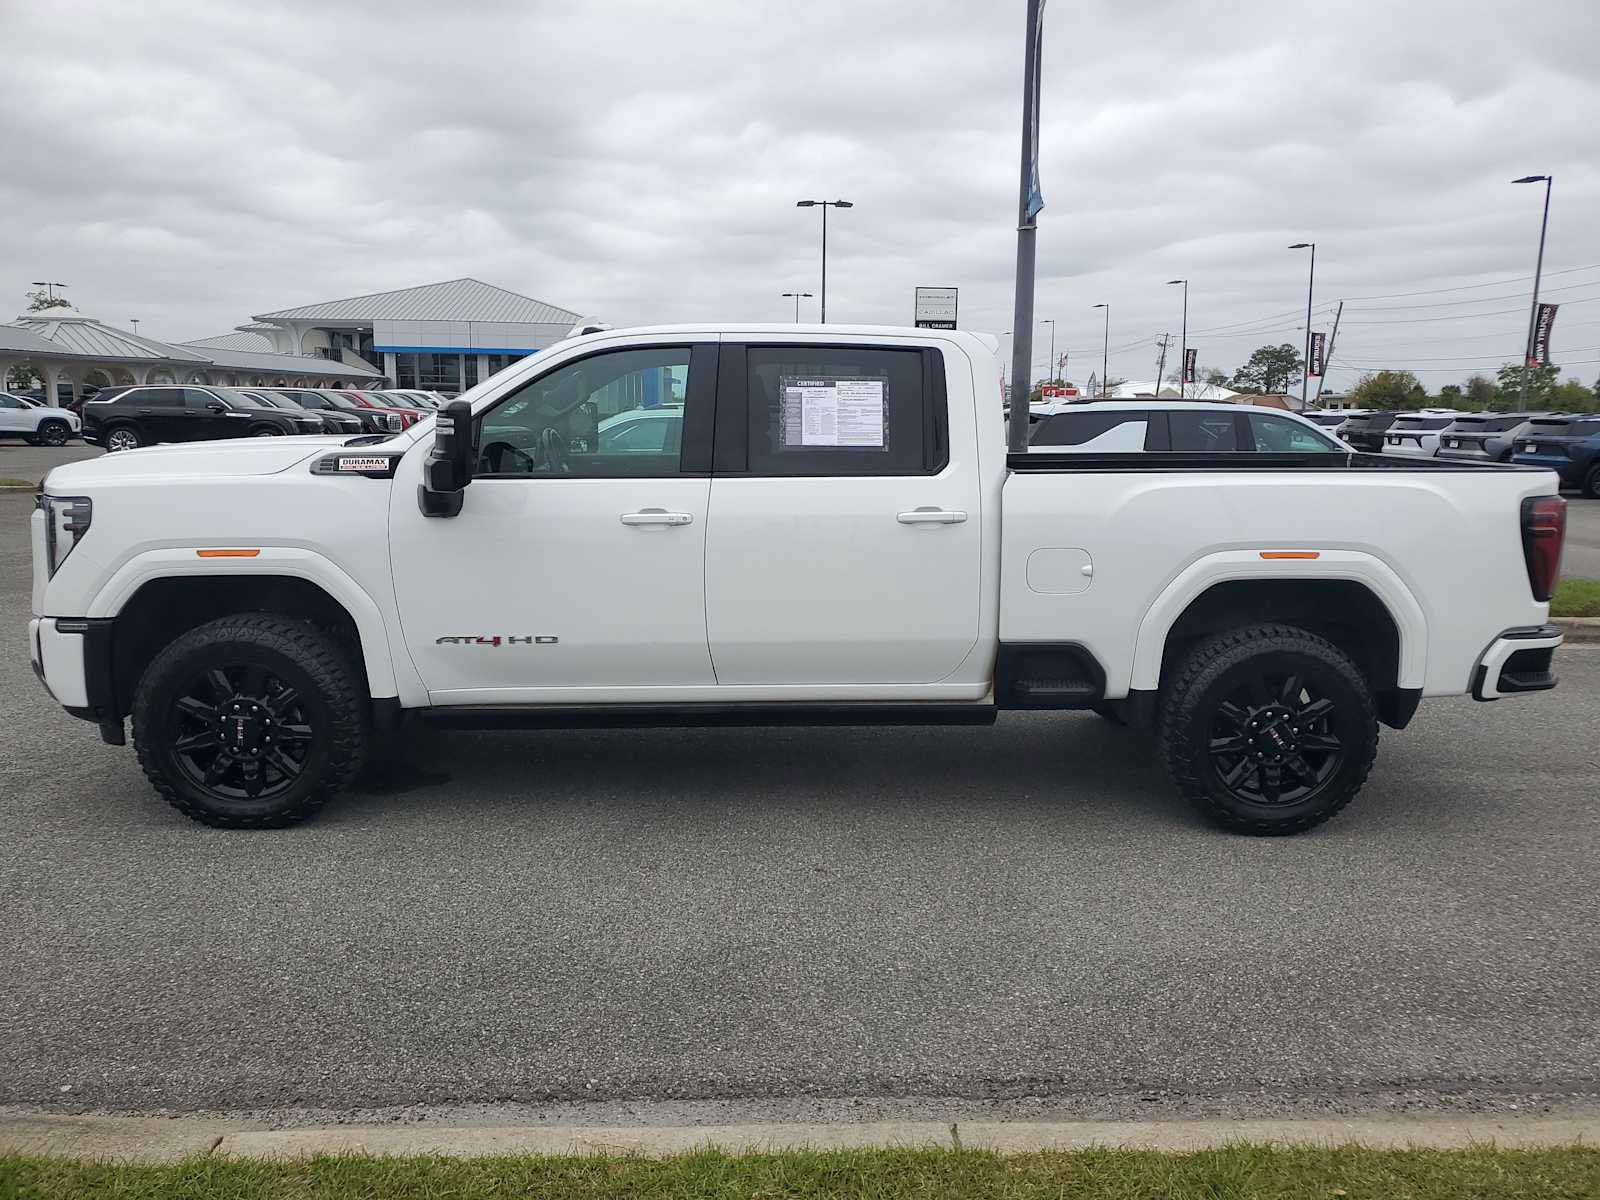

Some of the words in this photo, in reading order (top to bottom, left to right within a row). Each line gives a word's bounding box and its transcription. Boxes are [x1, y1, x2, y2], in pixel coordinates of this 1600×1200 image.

[1538, 307, 1551, 341] TRUCKS
[1536, 343, 1544, 363] NEW
[435, 636, 502, 647] AT4
[508, 636, 559, 644] HD
